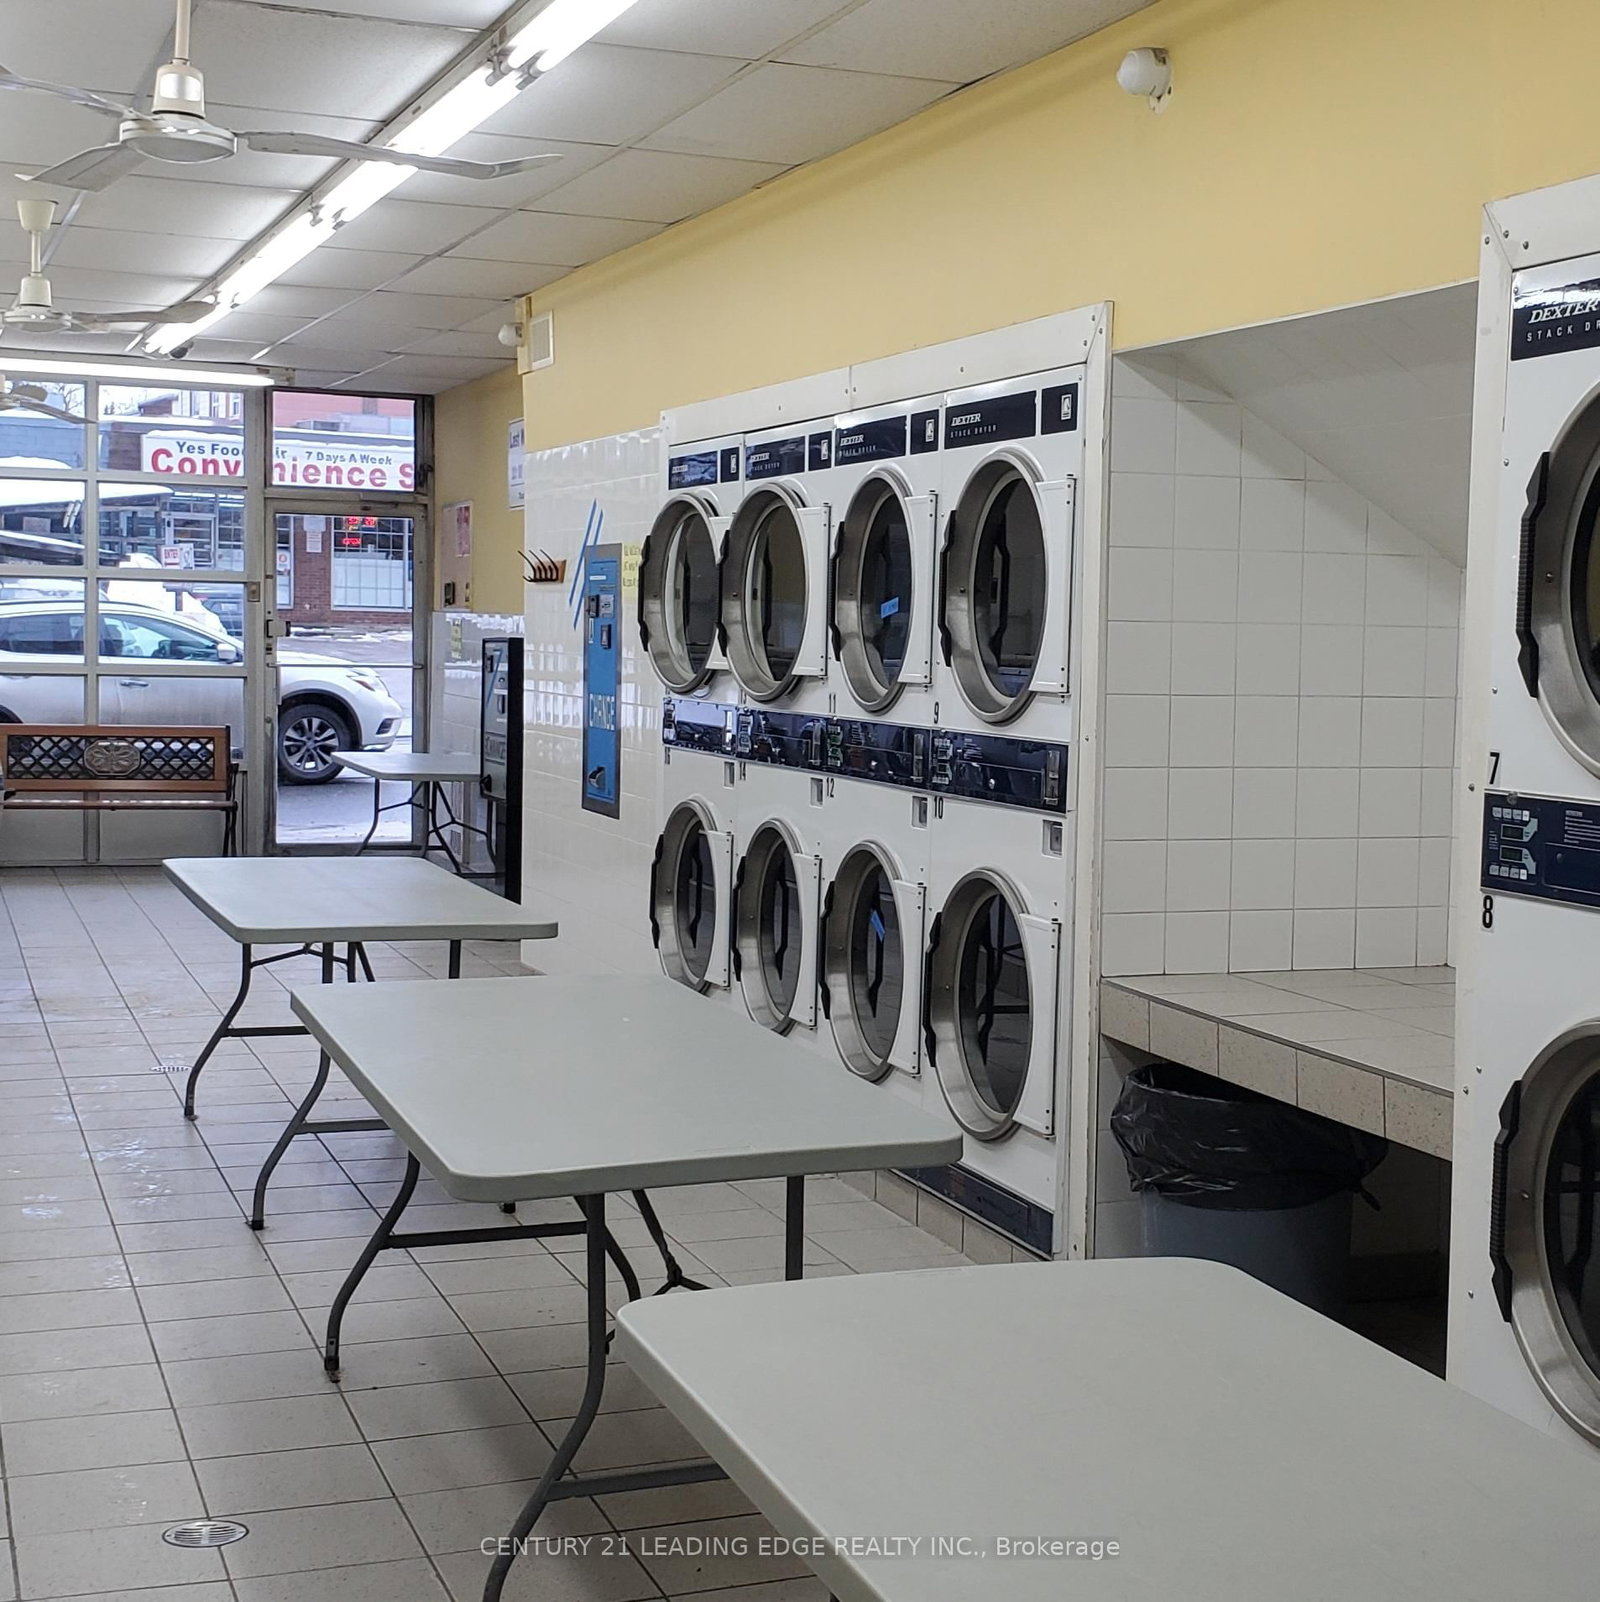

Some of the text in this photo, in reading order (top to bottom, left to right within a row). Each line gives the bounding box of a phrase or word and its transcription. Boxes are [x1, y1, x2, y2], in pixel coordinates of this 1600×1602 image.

[1528, 299, 1599, 324] DEXTER
[1526, 325, 1573, 342] STACK
[950, 413, 981, 427] DEXTER
[176, 441, 206, 454] Yes
[211, 444, 244, 456] Foo
[305, 451, 313, 460] 7
[317, 452, 346, 464] Days
[349, 454, 357, 463] A
[360, 454, 392, 465] Week
[933, 701, 940, 724] 9
[1489, 752, 1501, 785] 7
[826, 777, 835, 798] 12
[934, 795, 943, 819] 10
[1482, 895, 1494, 929] 8
